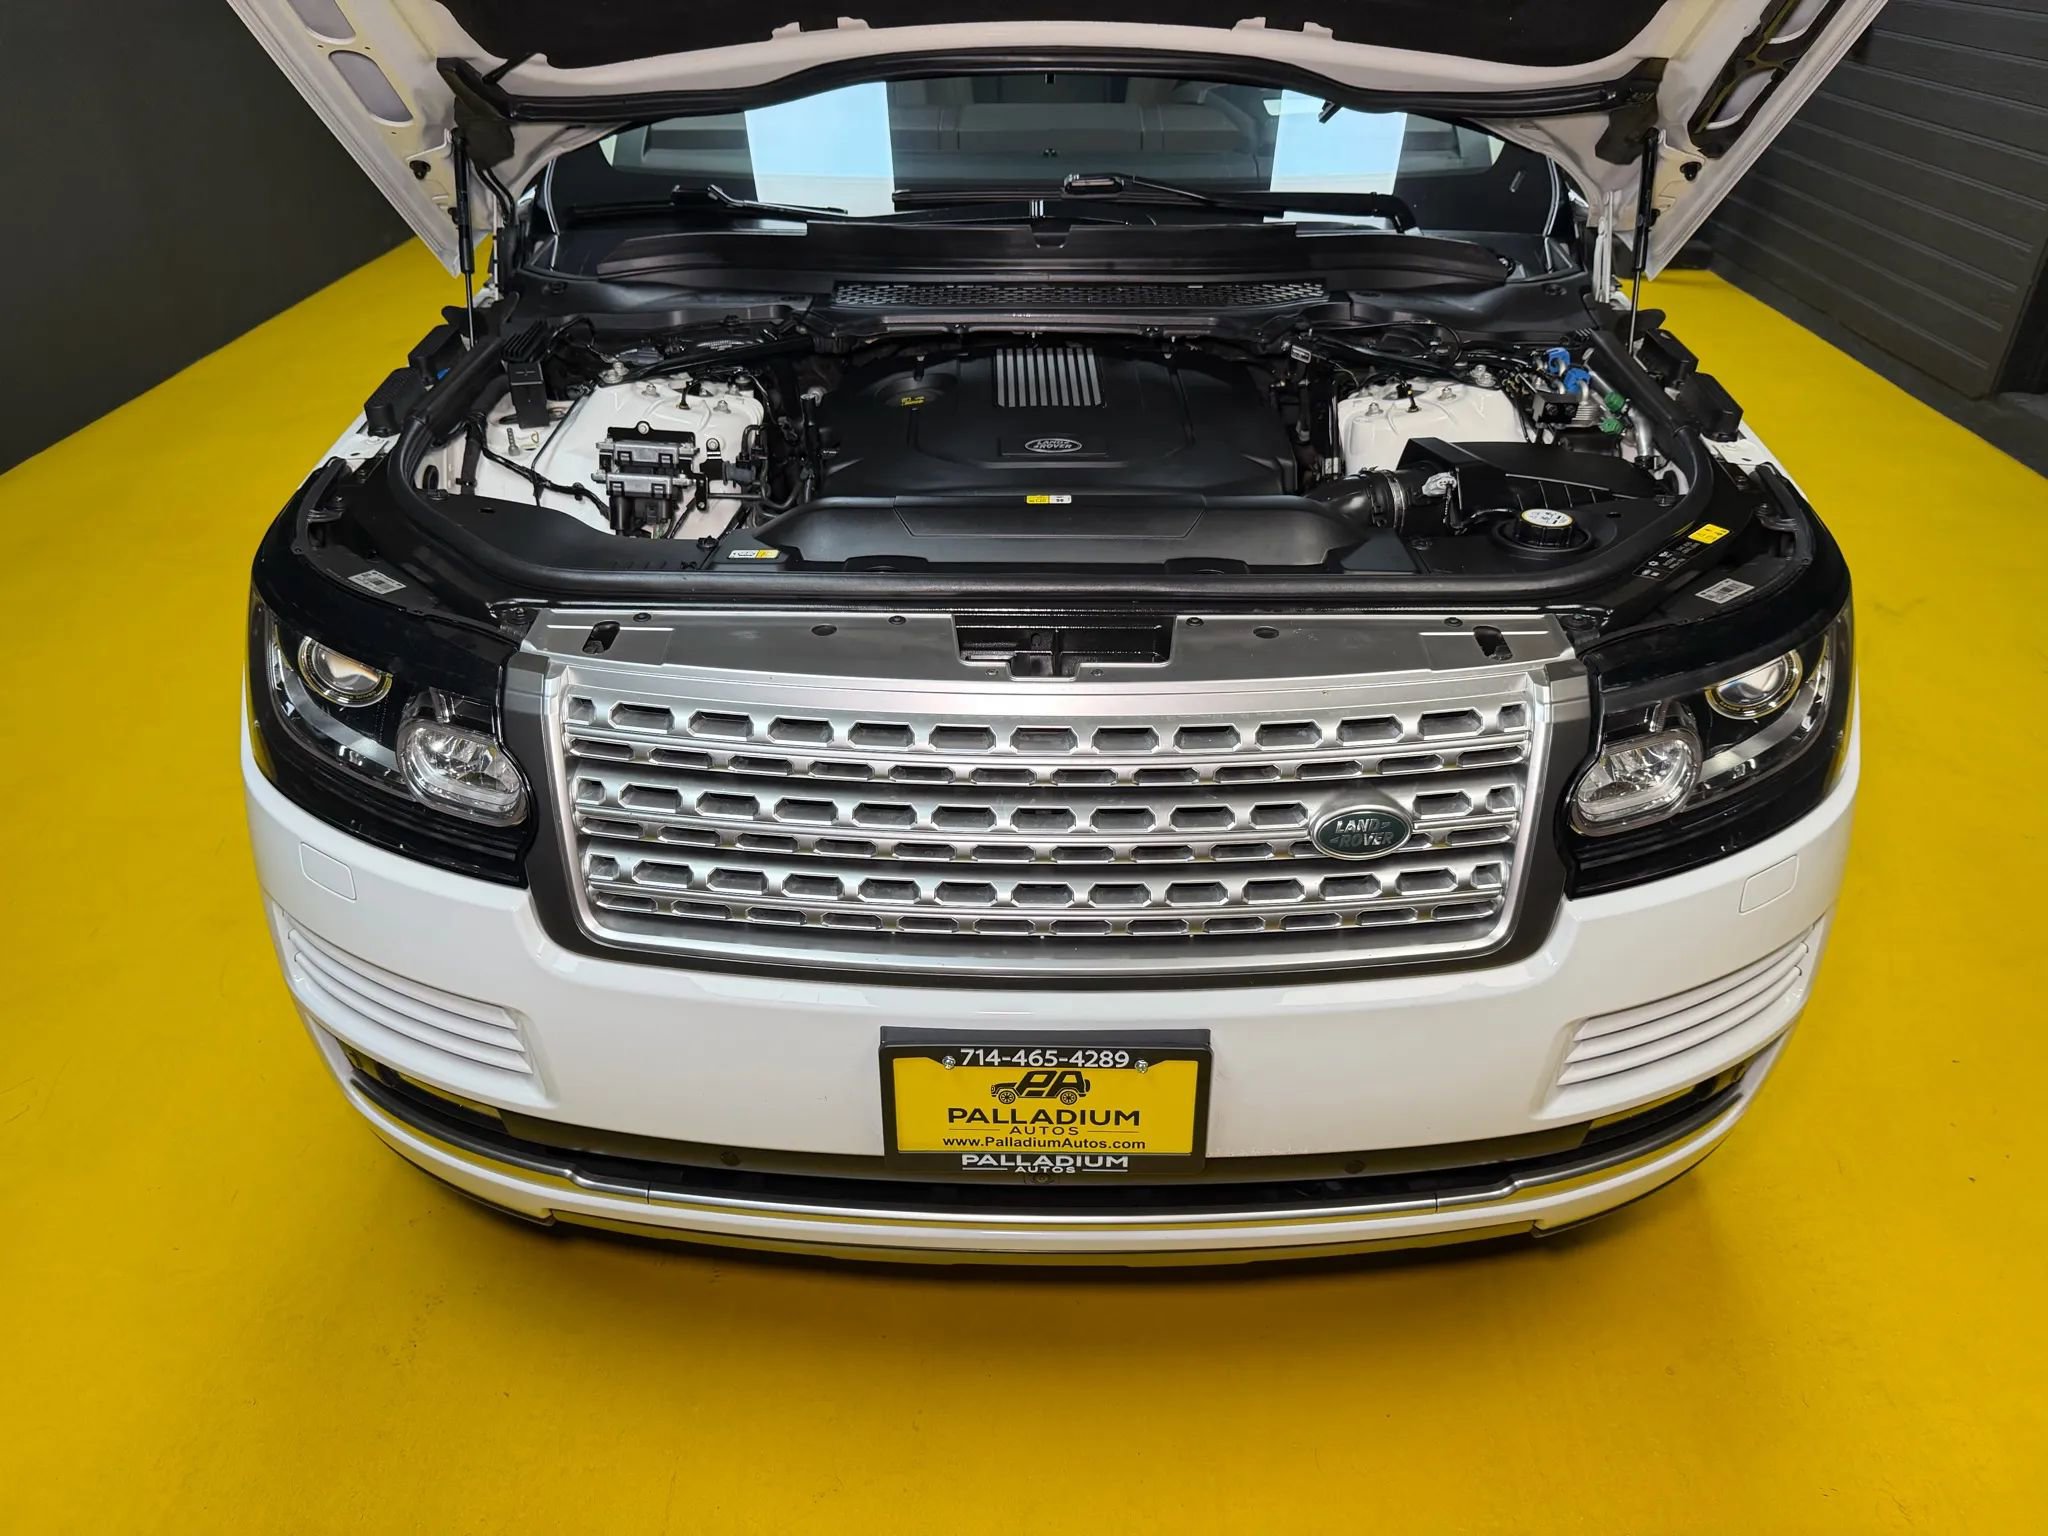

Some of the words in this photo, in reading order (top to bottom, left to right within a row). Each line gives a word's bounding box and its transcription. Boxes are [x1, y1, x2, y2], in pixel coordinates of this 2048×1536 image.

[1335, 818, 1379, 833] LAND
[1338, 832, 1394, 848] ROVER
[960, 1048, 1129, 1068] 714-465-4289
[948, 1107, 1140, 1126] PALLADIUM
[1009, 1126, 1079, 1136] AUTOS
[943, 1136, 1146, 1149] www.PalladiumAutos.com
[962, 1154, 1129, 1168] PALLADIUM
[1014, 1166, 1076, 1174] AUTOS
